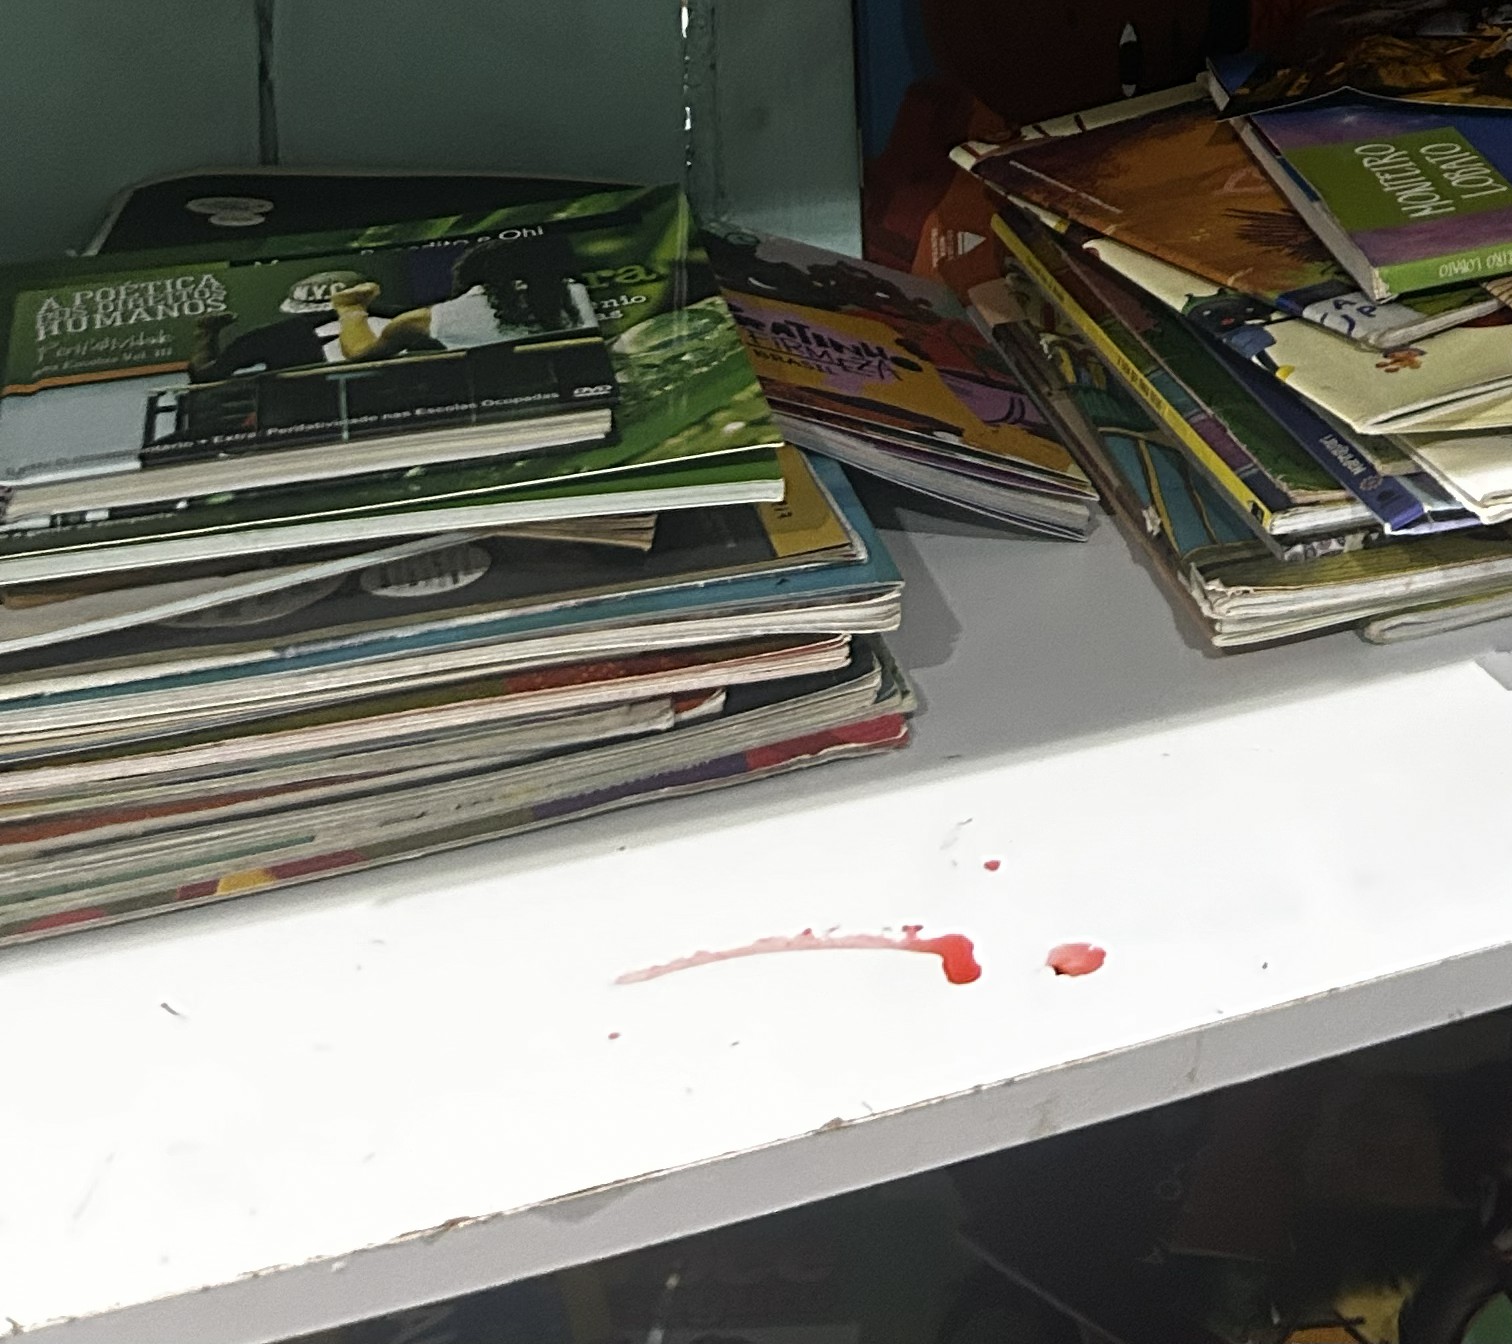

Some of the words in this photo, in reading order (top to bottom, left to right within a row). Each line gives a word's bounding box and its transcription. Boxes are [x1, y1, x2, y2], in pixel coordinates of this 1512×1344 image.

[1354, 142, 1456, 218] MONTEIRO
[1419, 141, 1509, 198] LOBATO
[70, 273, 221, 307] POÉTICA
[1438, 254, 1496, 279] LOBATO
[35, 294, 228, 341] HUMANOS
